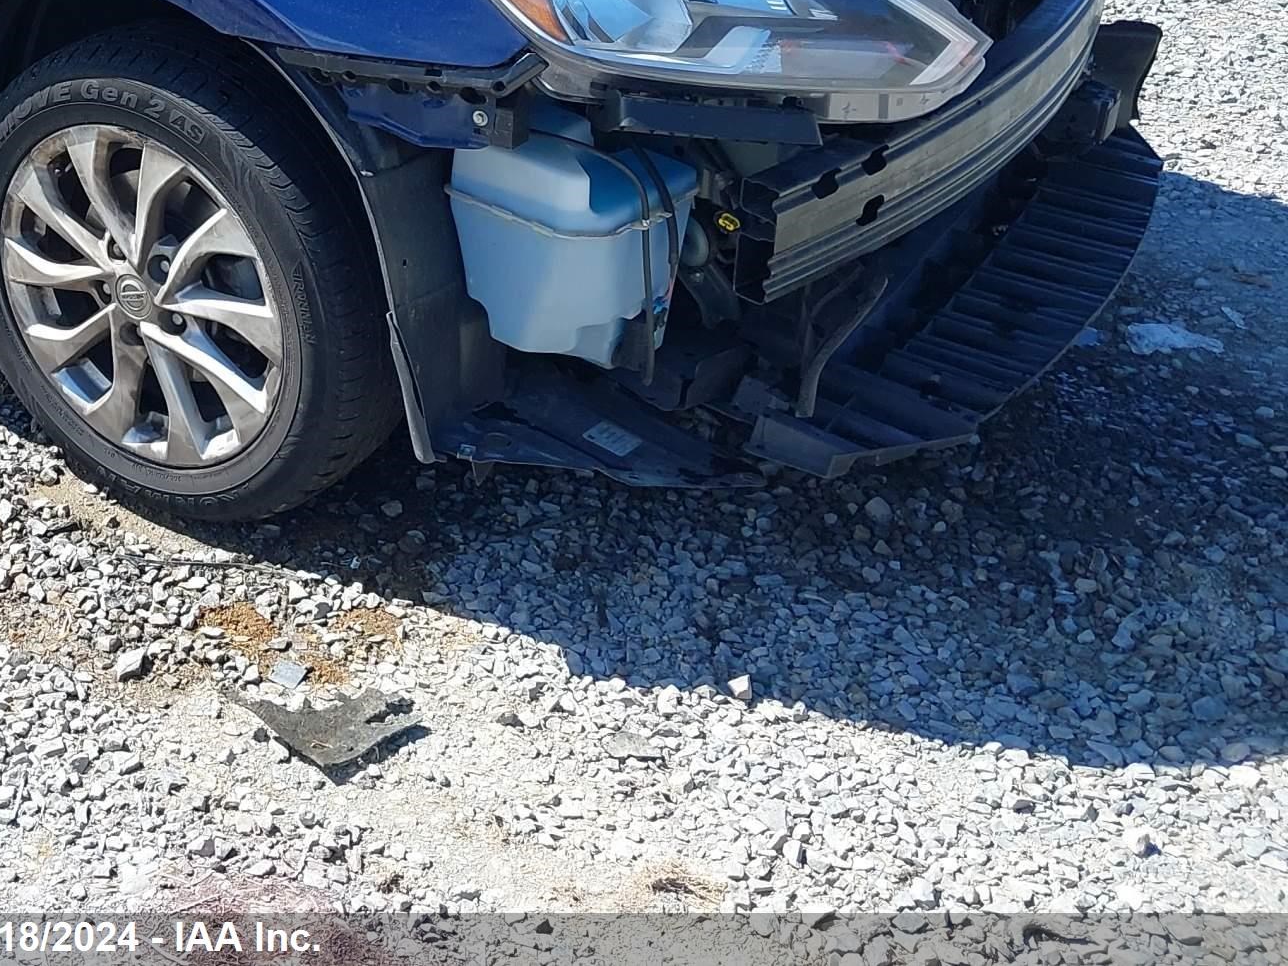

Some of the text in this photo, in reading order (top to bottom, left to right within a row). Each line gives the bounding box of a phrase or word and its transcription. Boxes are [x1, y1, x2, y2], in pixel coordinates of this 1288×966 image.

[80, 80, 138, 109] Gen
[143, 98, 166, 119] 2
[170, 111, 205, 143] AS
